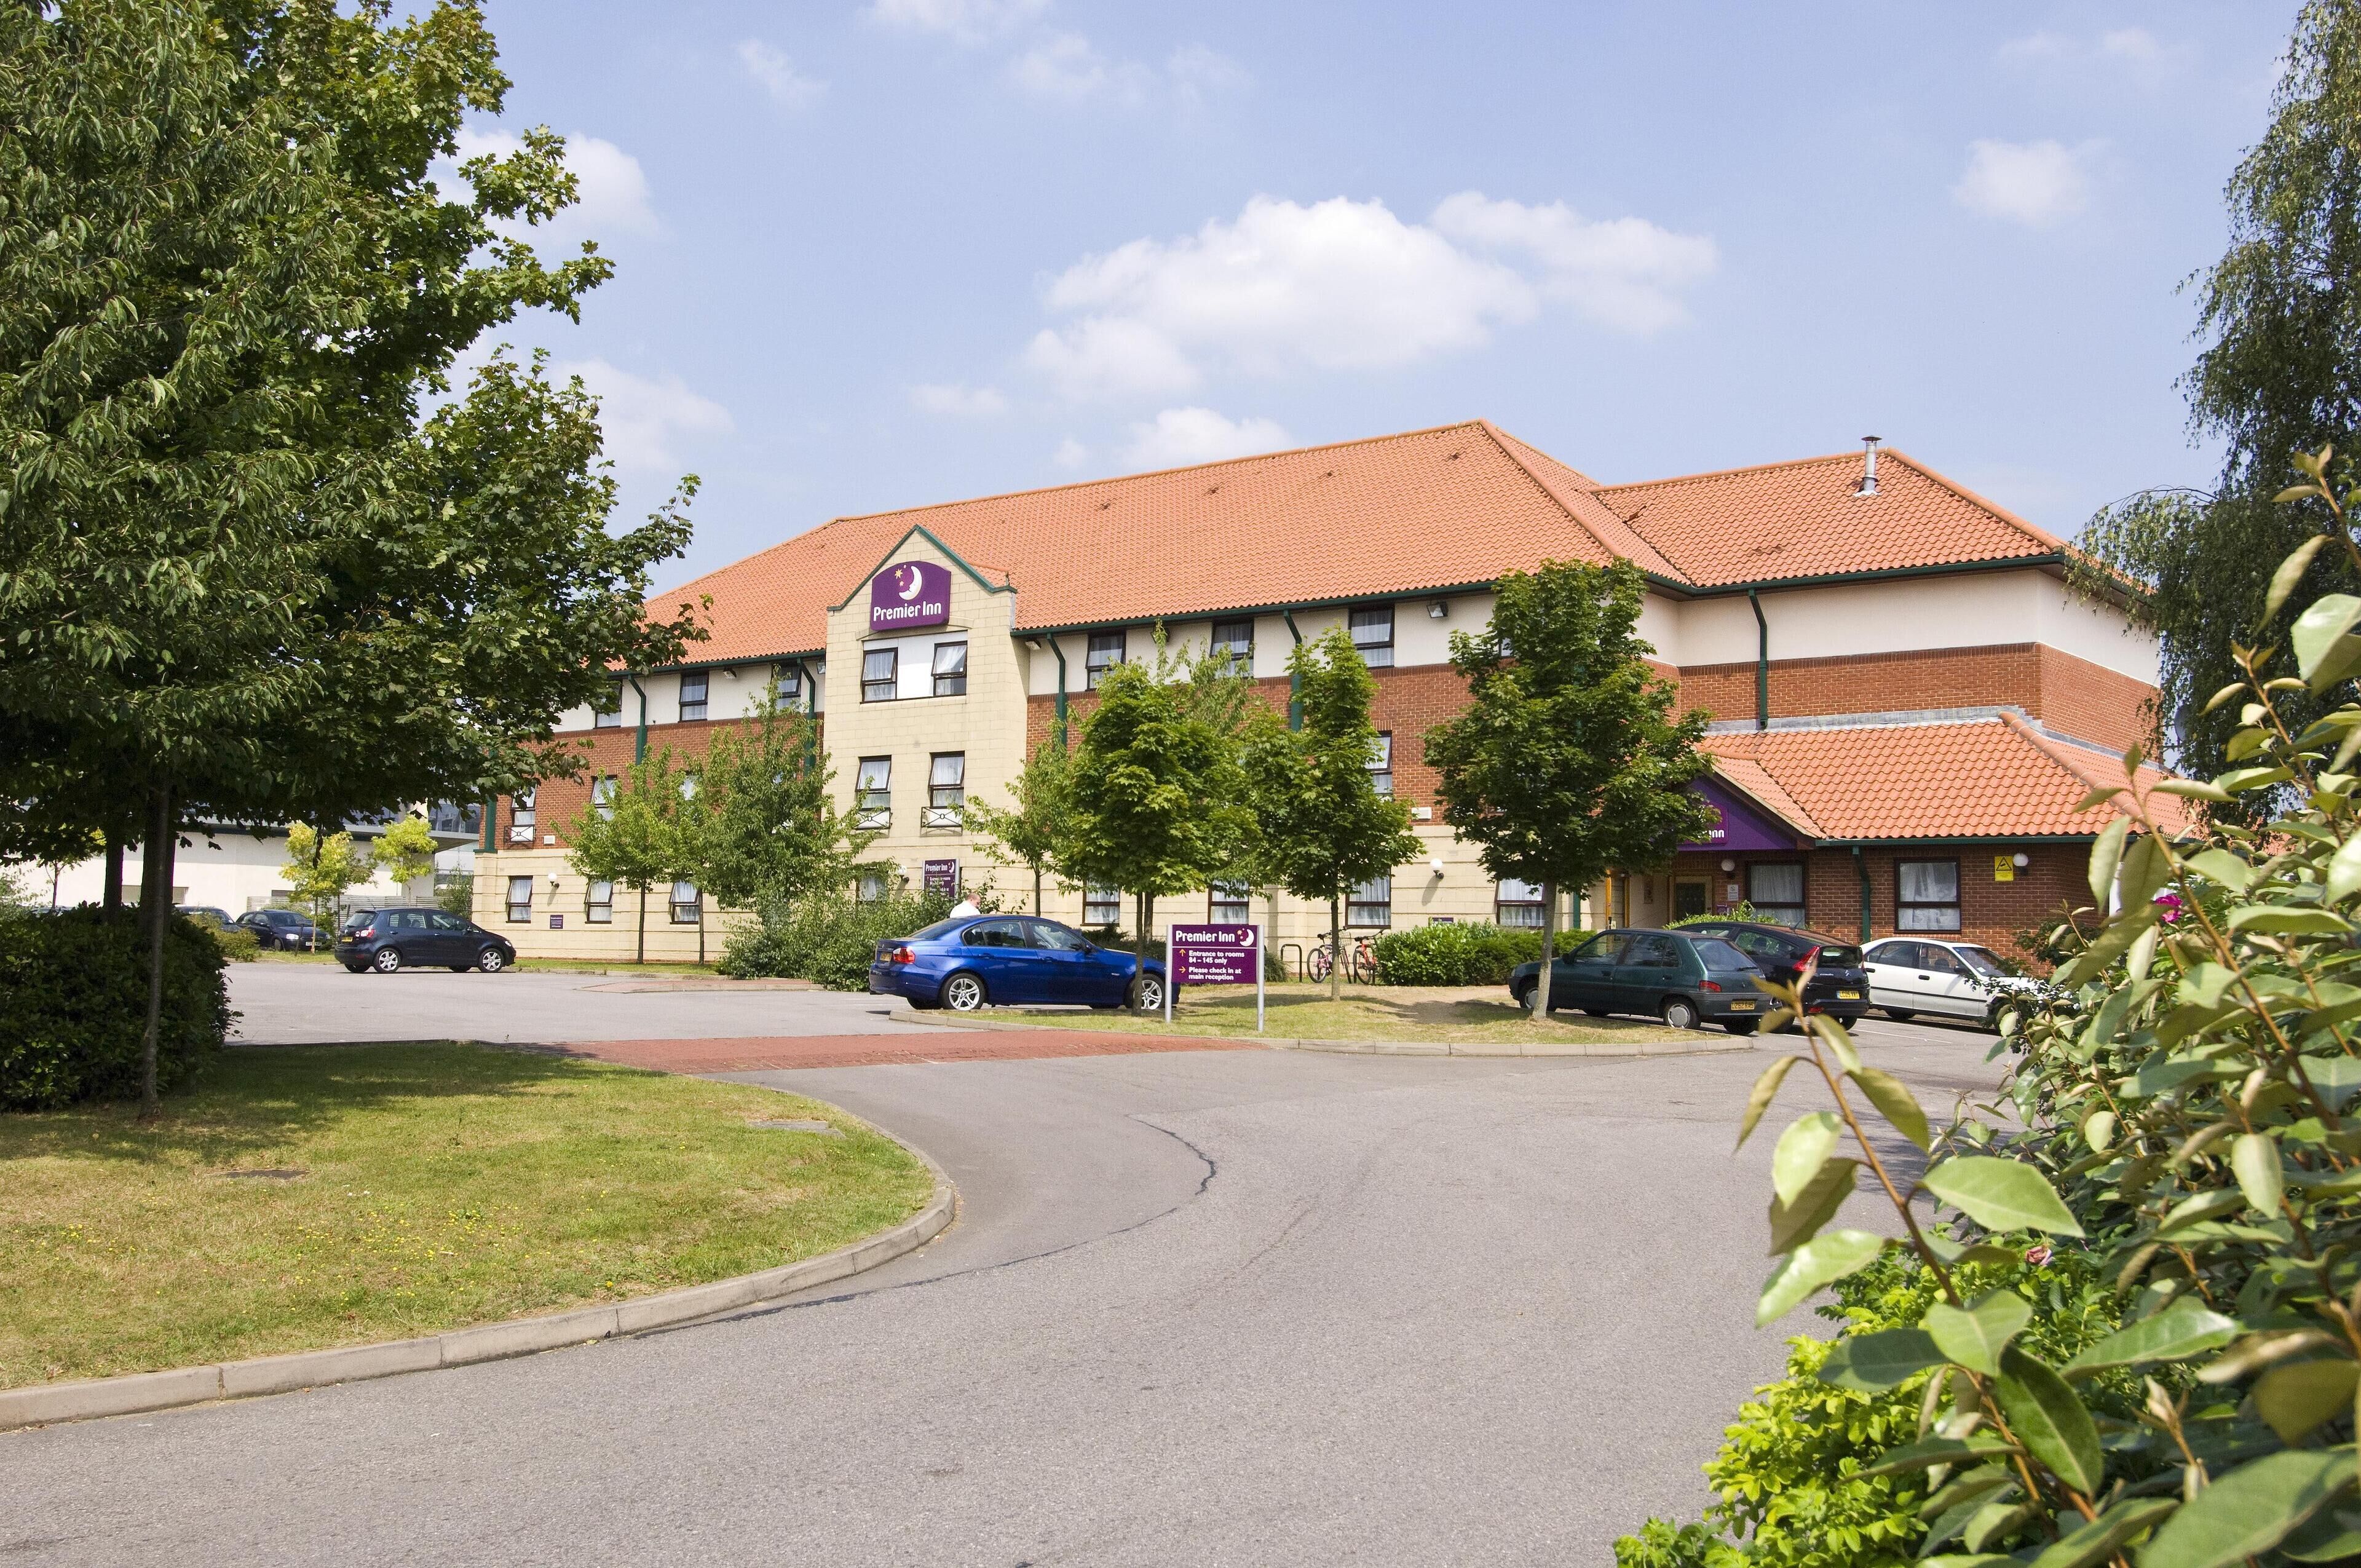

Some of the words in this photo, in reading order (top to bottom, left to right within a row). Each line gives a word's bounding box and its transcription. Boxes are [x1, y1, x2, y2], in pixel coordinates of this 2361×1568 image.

[873, 603, 921, 622] Premier
[922, 601, 941, 616] Inn
[1176, 930, 1217, 942] Premier
[1219, 931, 1235, 942] Inn
